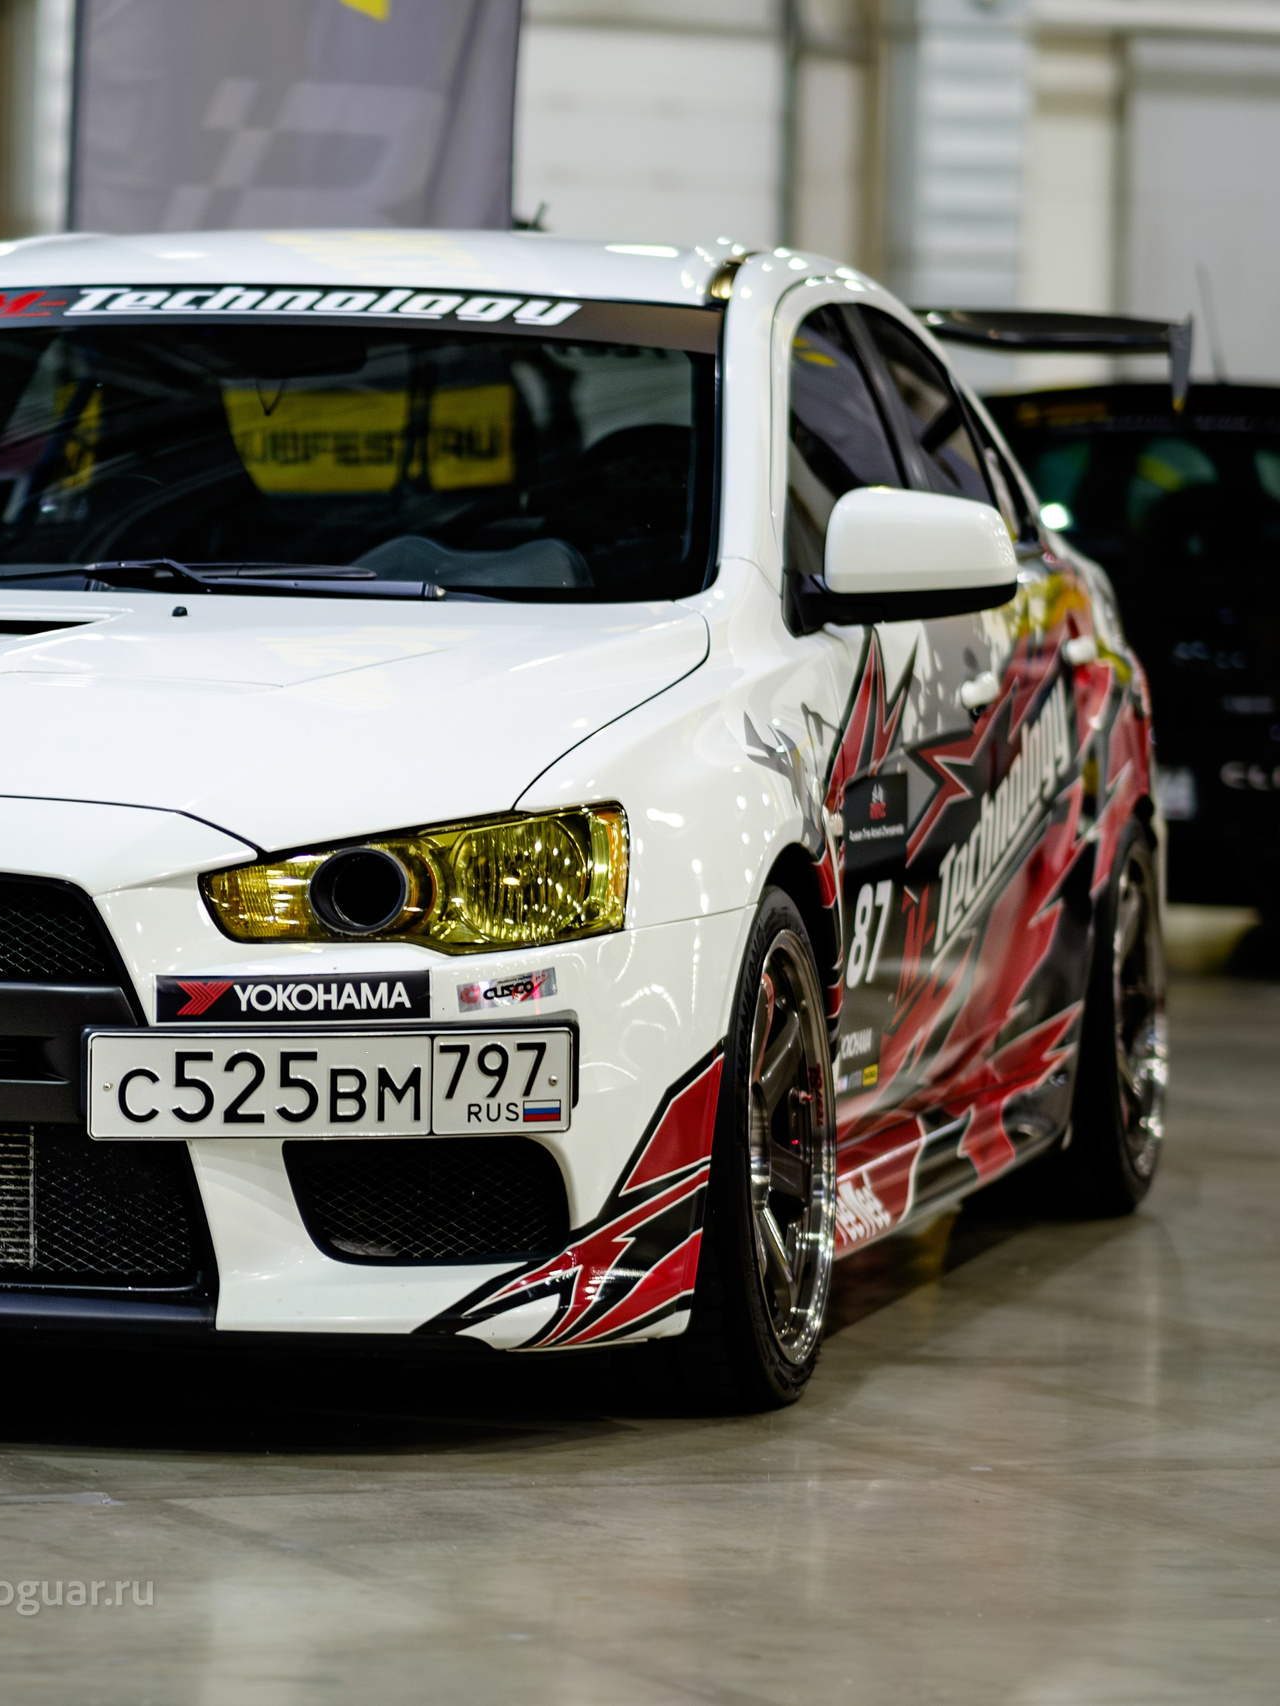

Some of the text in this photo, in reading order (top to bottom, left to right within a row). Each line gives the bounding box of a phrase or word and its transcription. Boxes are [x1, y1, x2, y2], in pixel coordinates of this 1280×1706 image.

[846, 879, 893, 990] 87
[233, 981, 412, 1012] YOKOHAMA
[438, 1042, 548, 1098] 797
[467, 1102, 520, 1122] RUS
